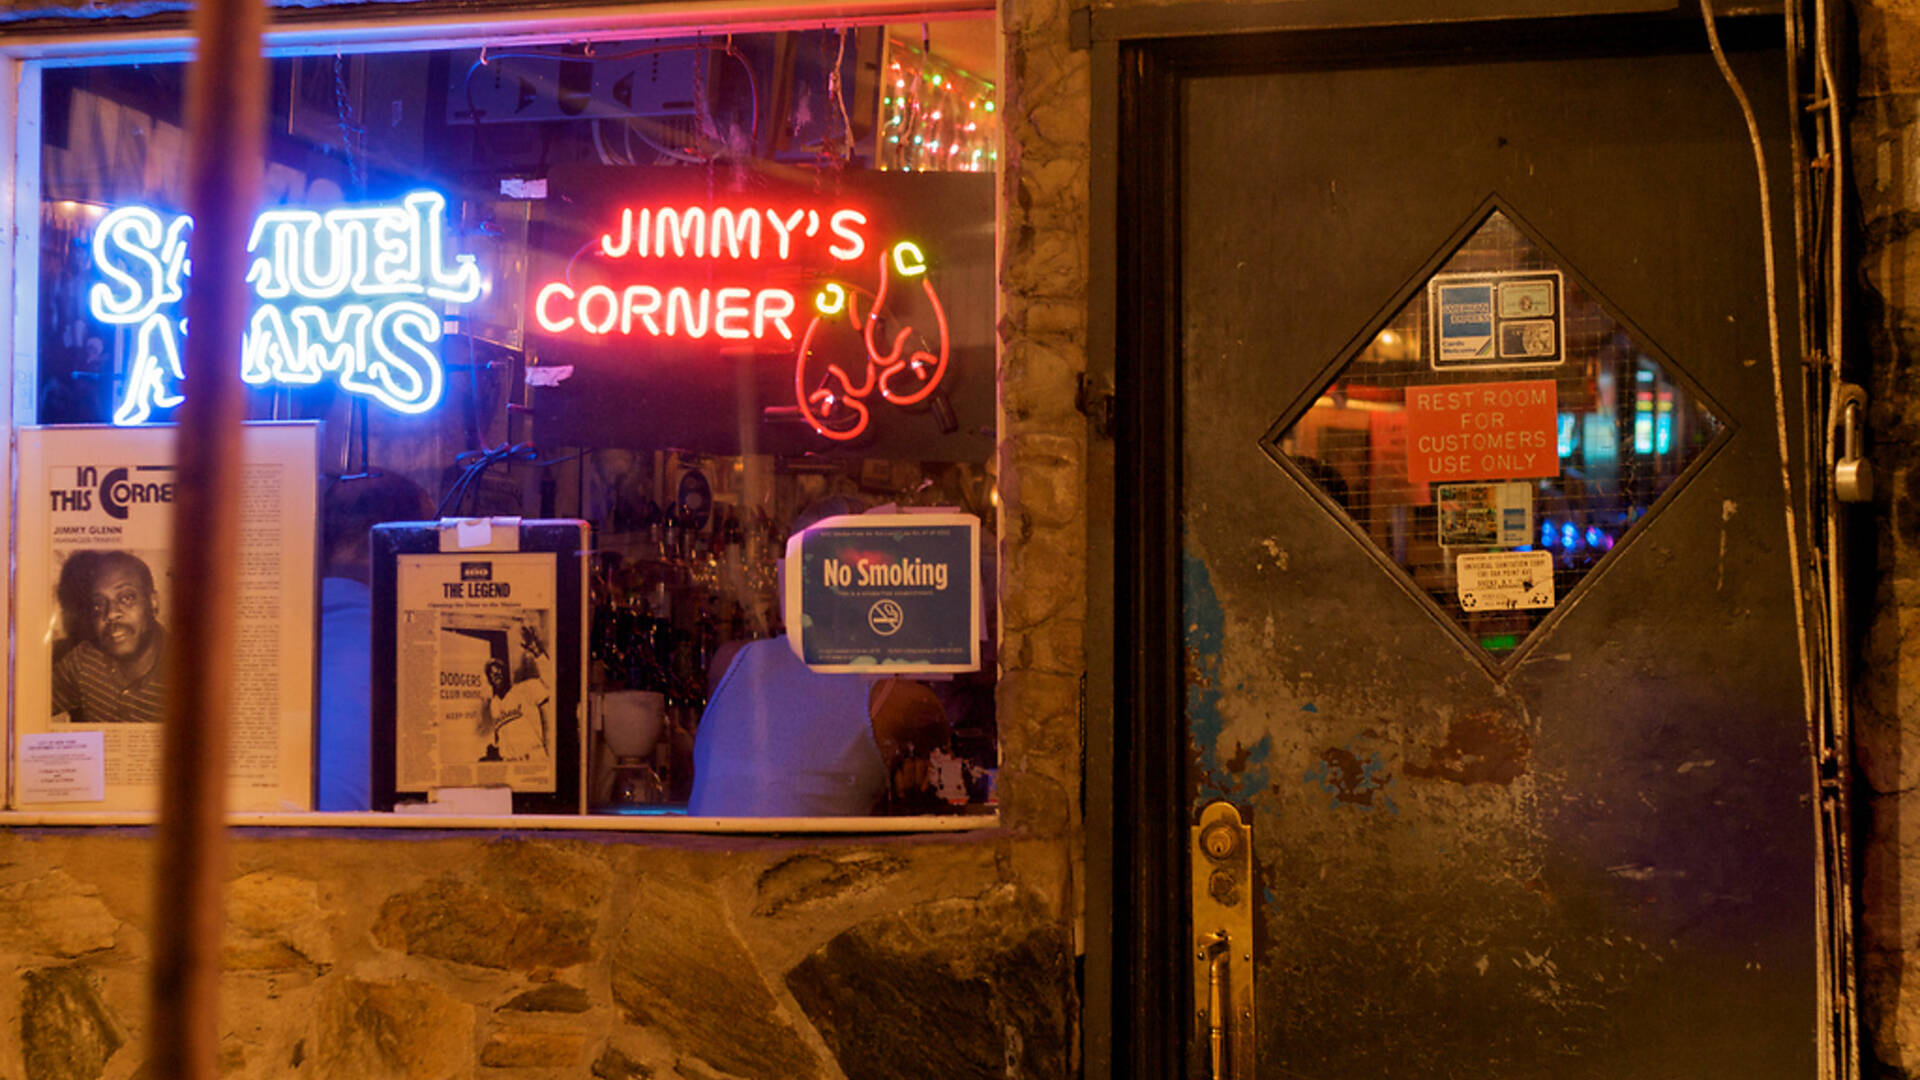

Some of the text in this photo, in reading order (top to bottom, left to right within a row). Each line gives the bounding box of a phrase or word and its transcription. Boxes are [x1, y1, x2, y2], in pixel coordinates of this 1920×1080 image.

[601, 206, 868, 261] JIMMY'S
[535, 282, 796, 340] CORNER
[113, 301, 443, 427] AAMS
[1418, 389, 1547, 411] REST ROOM
[1461, 412, 1505, 430] FOR
[1418, 430, 1547, 453] CUSTOMERS
[1428, 453, 1537, 474] USE ONLY
[77, 466, 97, 487] IN
[50, 467, 175, 520] THIS CORNE
[53, 526, 122, 535] JIMMY GLENN
[823, 557, 948, 590] No Smoking
[442, 582, 511, 598] THE LEGEND
[440, 671, 481, 687] DODGERS
[440, 689, 460, 699] CLUB
